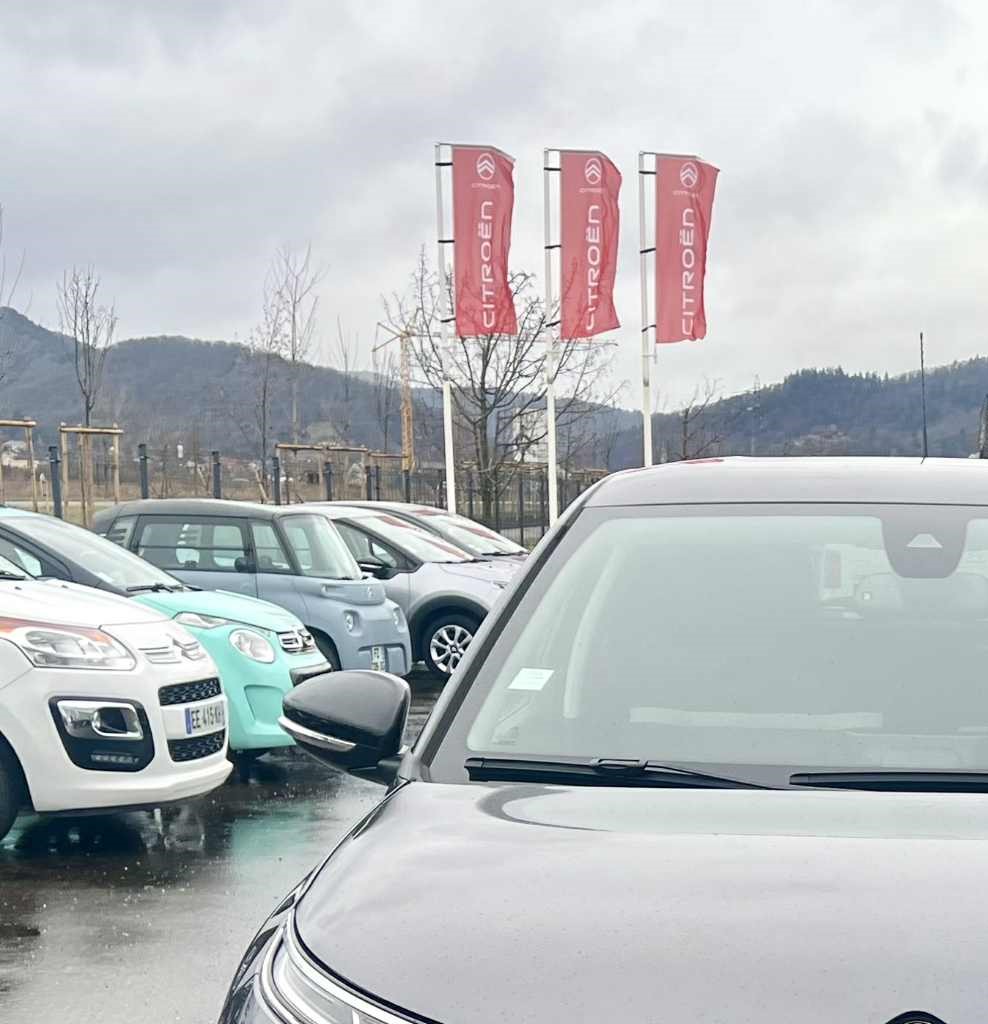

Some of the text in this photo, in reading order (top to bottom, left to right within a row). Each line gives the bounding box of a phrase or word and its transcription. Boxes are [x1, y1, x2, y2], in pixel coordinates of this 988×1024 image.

[478, 200, 495, 328] CITROËN
[585, 204, 601, 330] CITROËN
[679, 208, 695, 336] CITROËN
